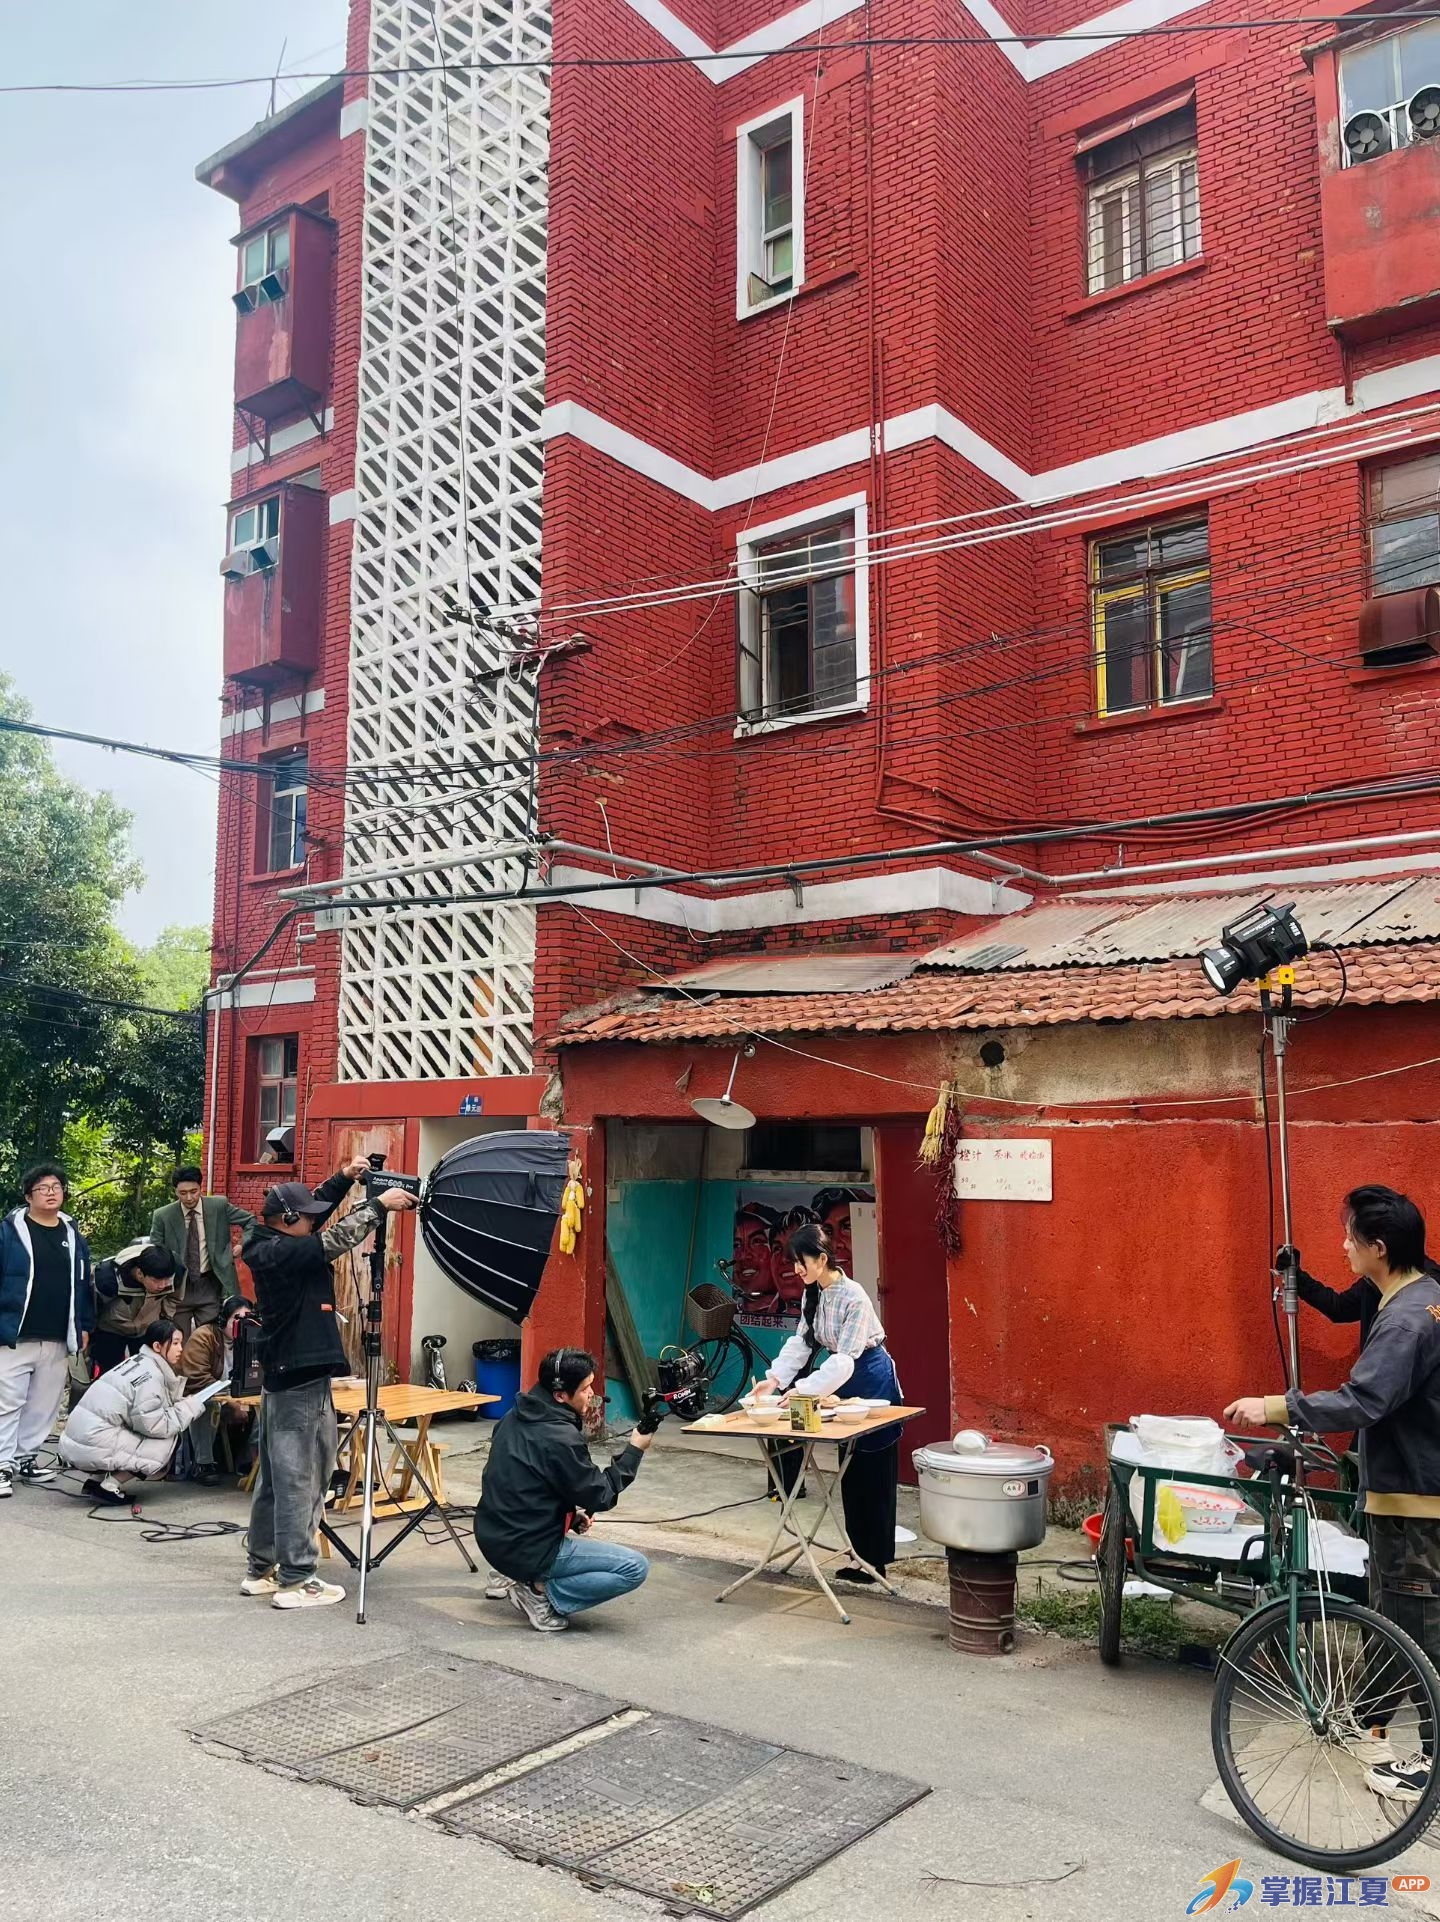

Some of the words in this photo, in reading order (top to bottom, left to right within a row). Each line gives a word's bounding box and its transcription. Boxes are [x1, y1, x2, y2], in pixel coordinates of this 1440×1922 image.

[994, 1148, 1013, 1161] 茶水
[741, 1314, 801, 1329] 团结起来、
